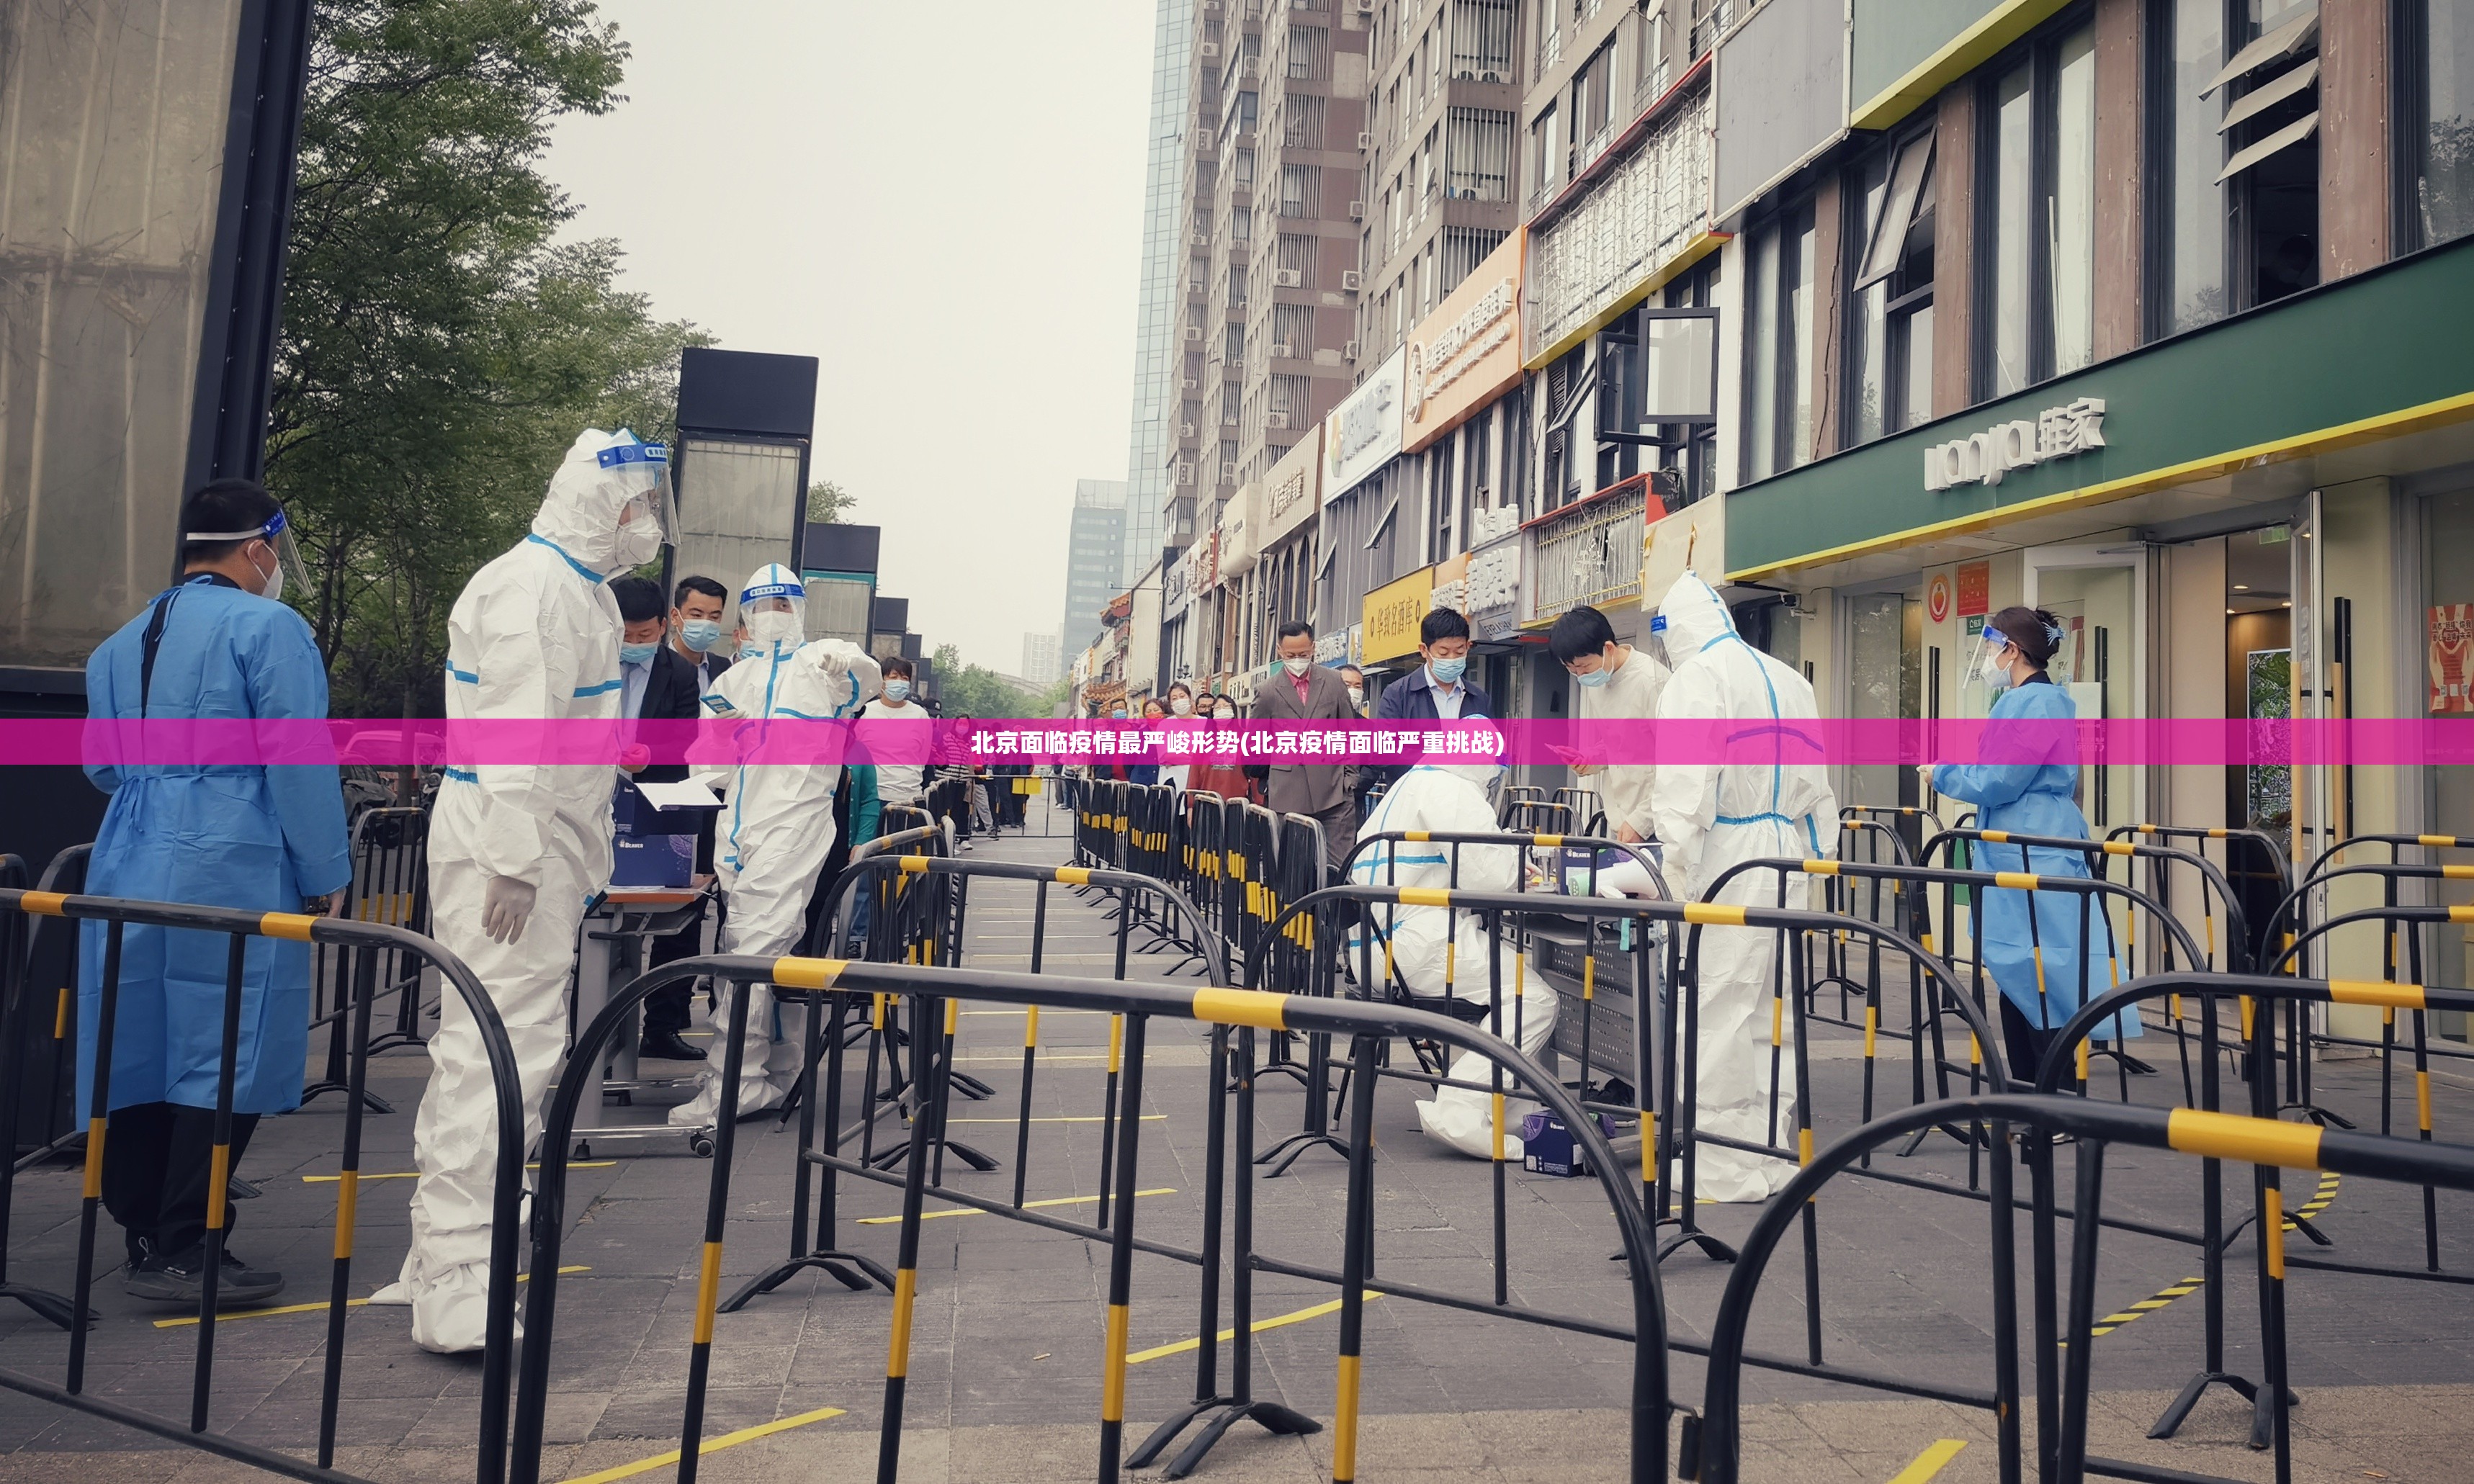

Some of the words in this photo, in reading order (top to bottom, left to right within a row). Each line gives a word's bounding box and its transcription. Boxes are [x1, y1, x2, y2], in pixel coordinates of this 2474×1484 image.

[2038, 397, 2106, 459] 链家
[1377, 595, 1412, 641] 华致名酒库
